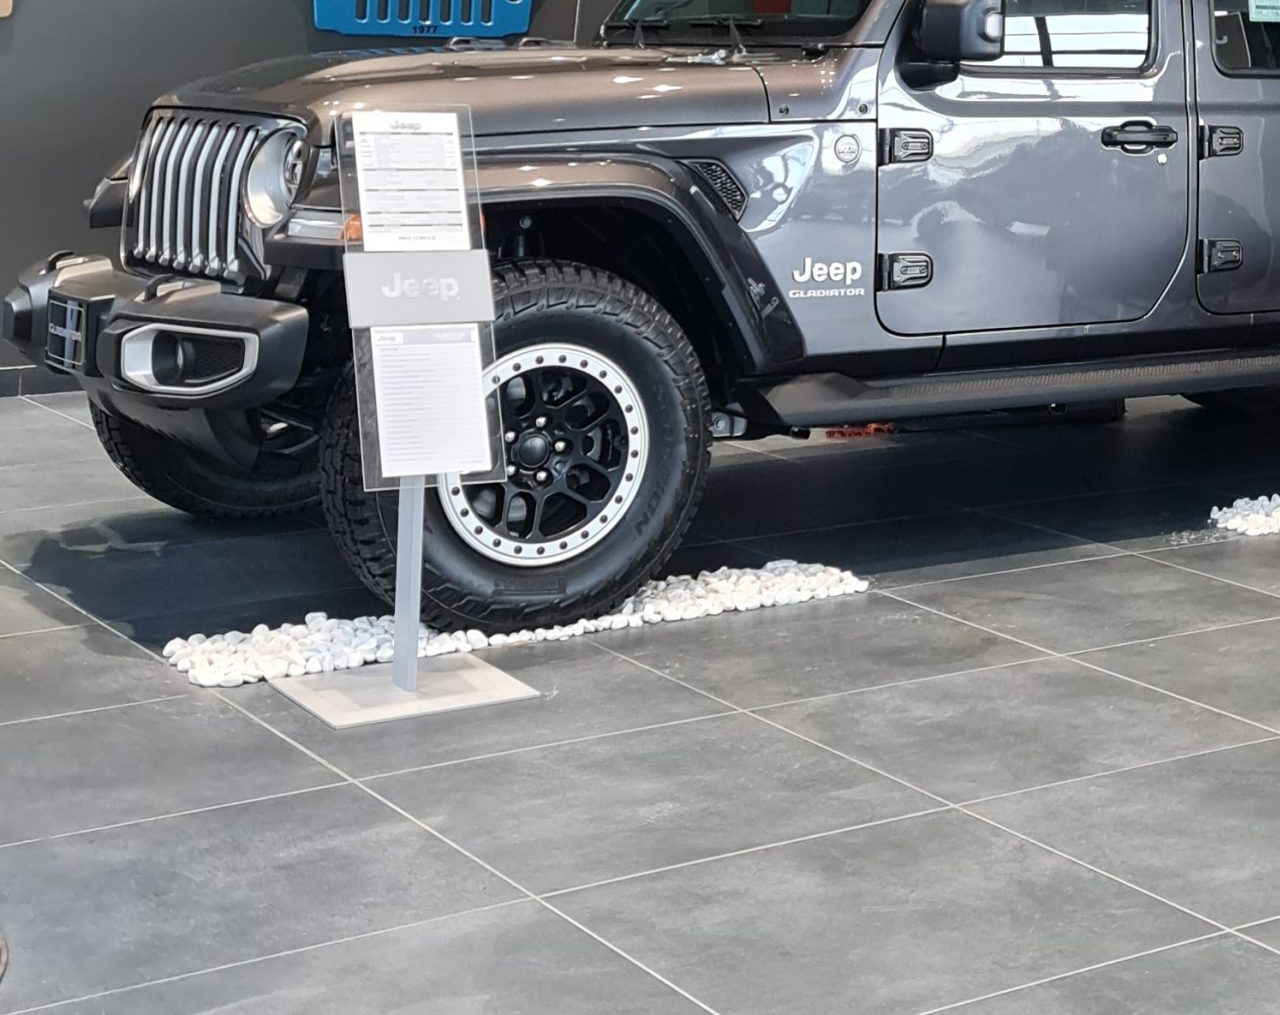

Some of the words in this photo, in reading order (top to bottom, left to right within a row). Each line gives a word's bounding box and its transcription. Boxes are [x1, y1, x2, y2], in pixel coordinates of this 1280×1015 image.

[412, 25, 439, 34] 1977
[792, 257, 862, 285] Jeep
[381, 272, 460, 301] Jeep
[788, 288, 866, 298] GLADIATOR
